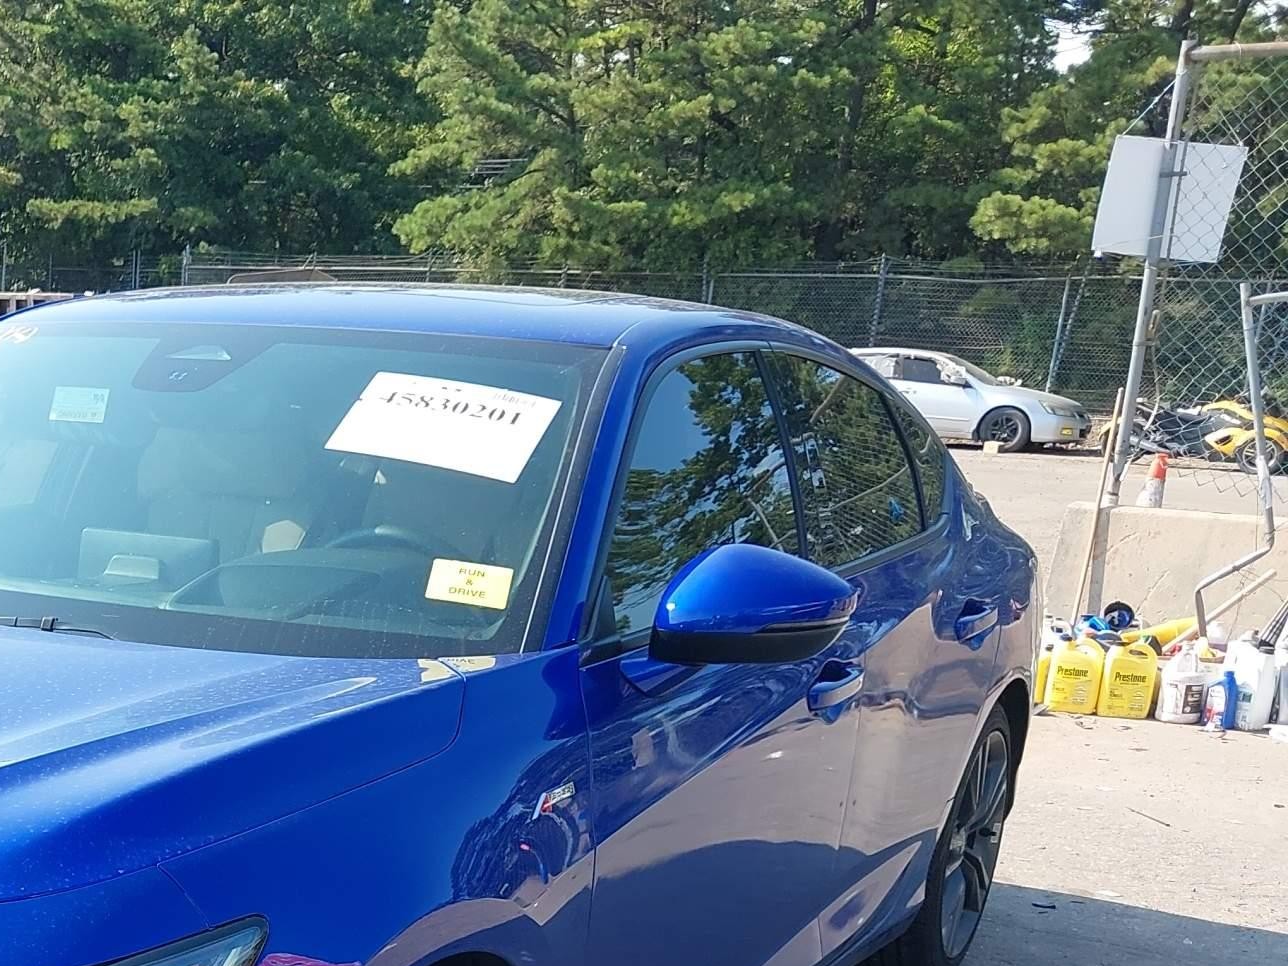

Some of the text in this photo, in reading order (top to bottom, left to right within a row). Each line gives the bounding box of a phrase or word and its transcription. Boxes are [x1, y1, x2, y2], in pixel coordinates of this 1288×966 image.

[379, 391, 521, 425] 45830201
[458, 567, 485, 577] RUN
[448, 586, 486, 598] DRIVE
[1057, 665, 1089, 678] Prestone
[1114, 671, 1147, 683] Prestone
